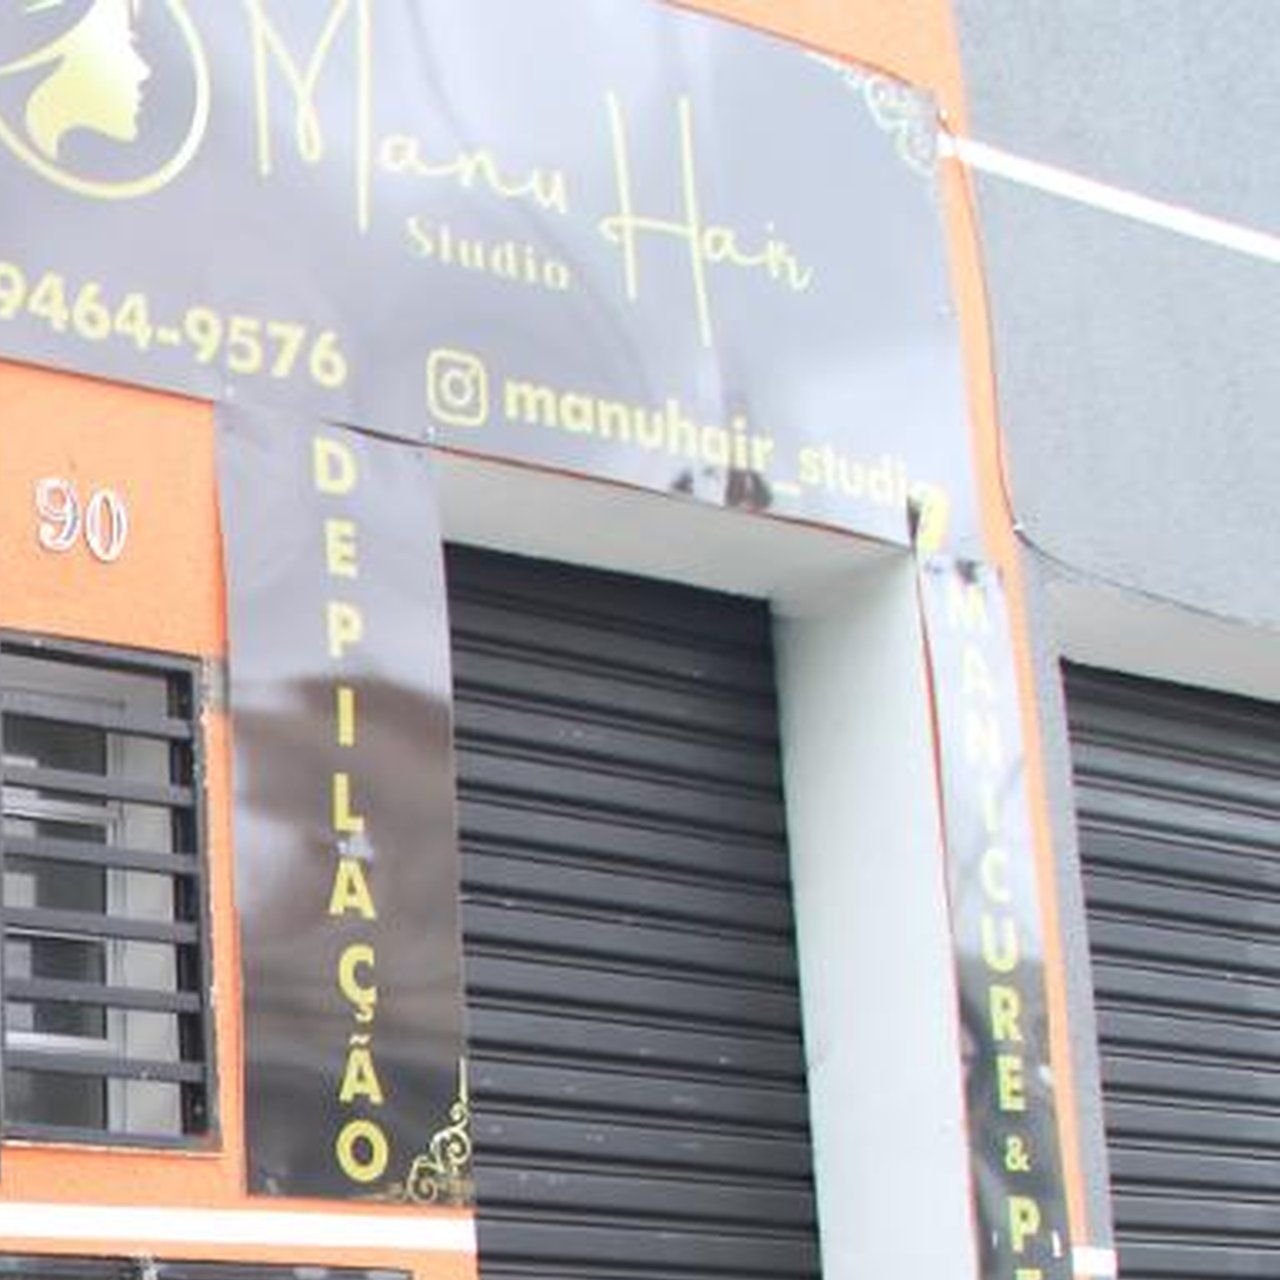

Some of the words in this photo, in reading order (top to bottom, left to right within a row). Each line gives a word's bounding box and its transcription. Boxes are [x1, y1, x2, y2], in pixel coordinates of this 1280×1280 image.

[249, 0, 569, 236] Manu
[598, 90, 815, 349] Hair
[404, 214, 577, 292] Studio
[34, 477, 128, 563] 90
[312, 435, 389, 1183] DEPILAÇÃO
[947, 576, 1028, 1112] MANICURE
[1005, 1135, 1032, 1172] &
